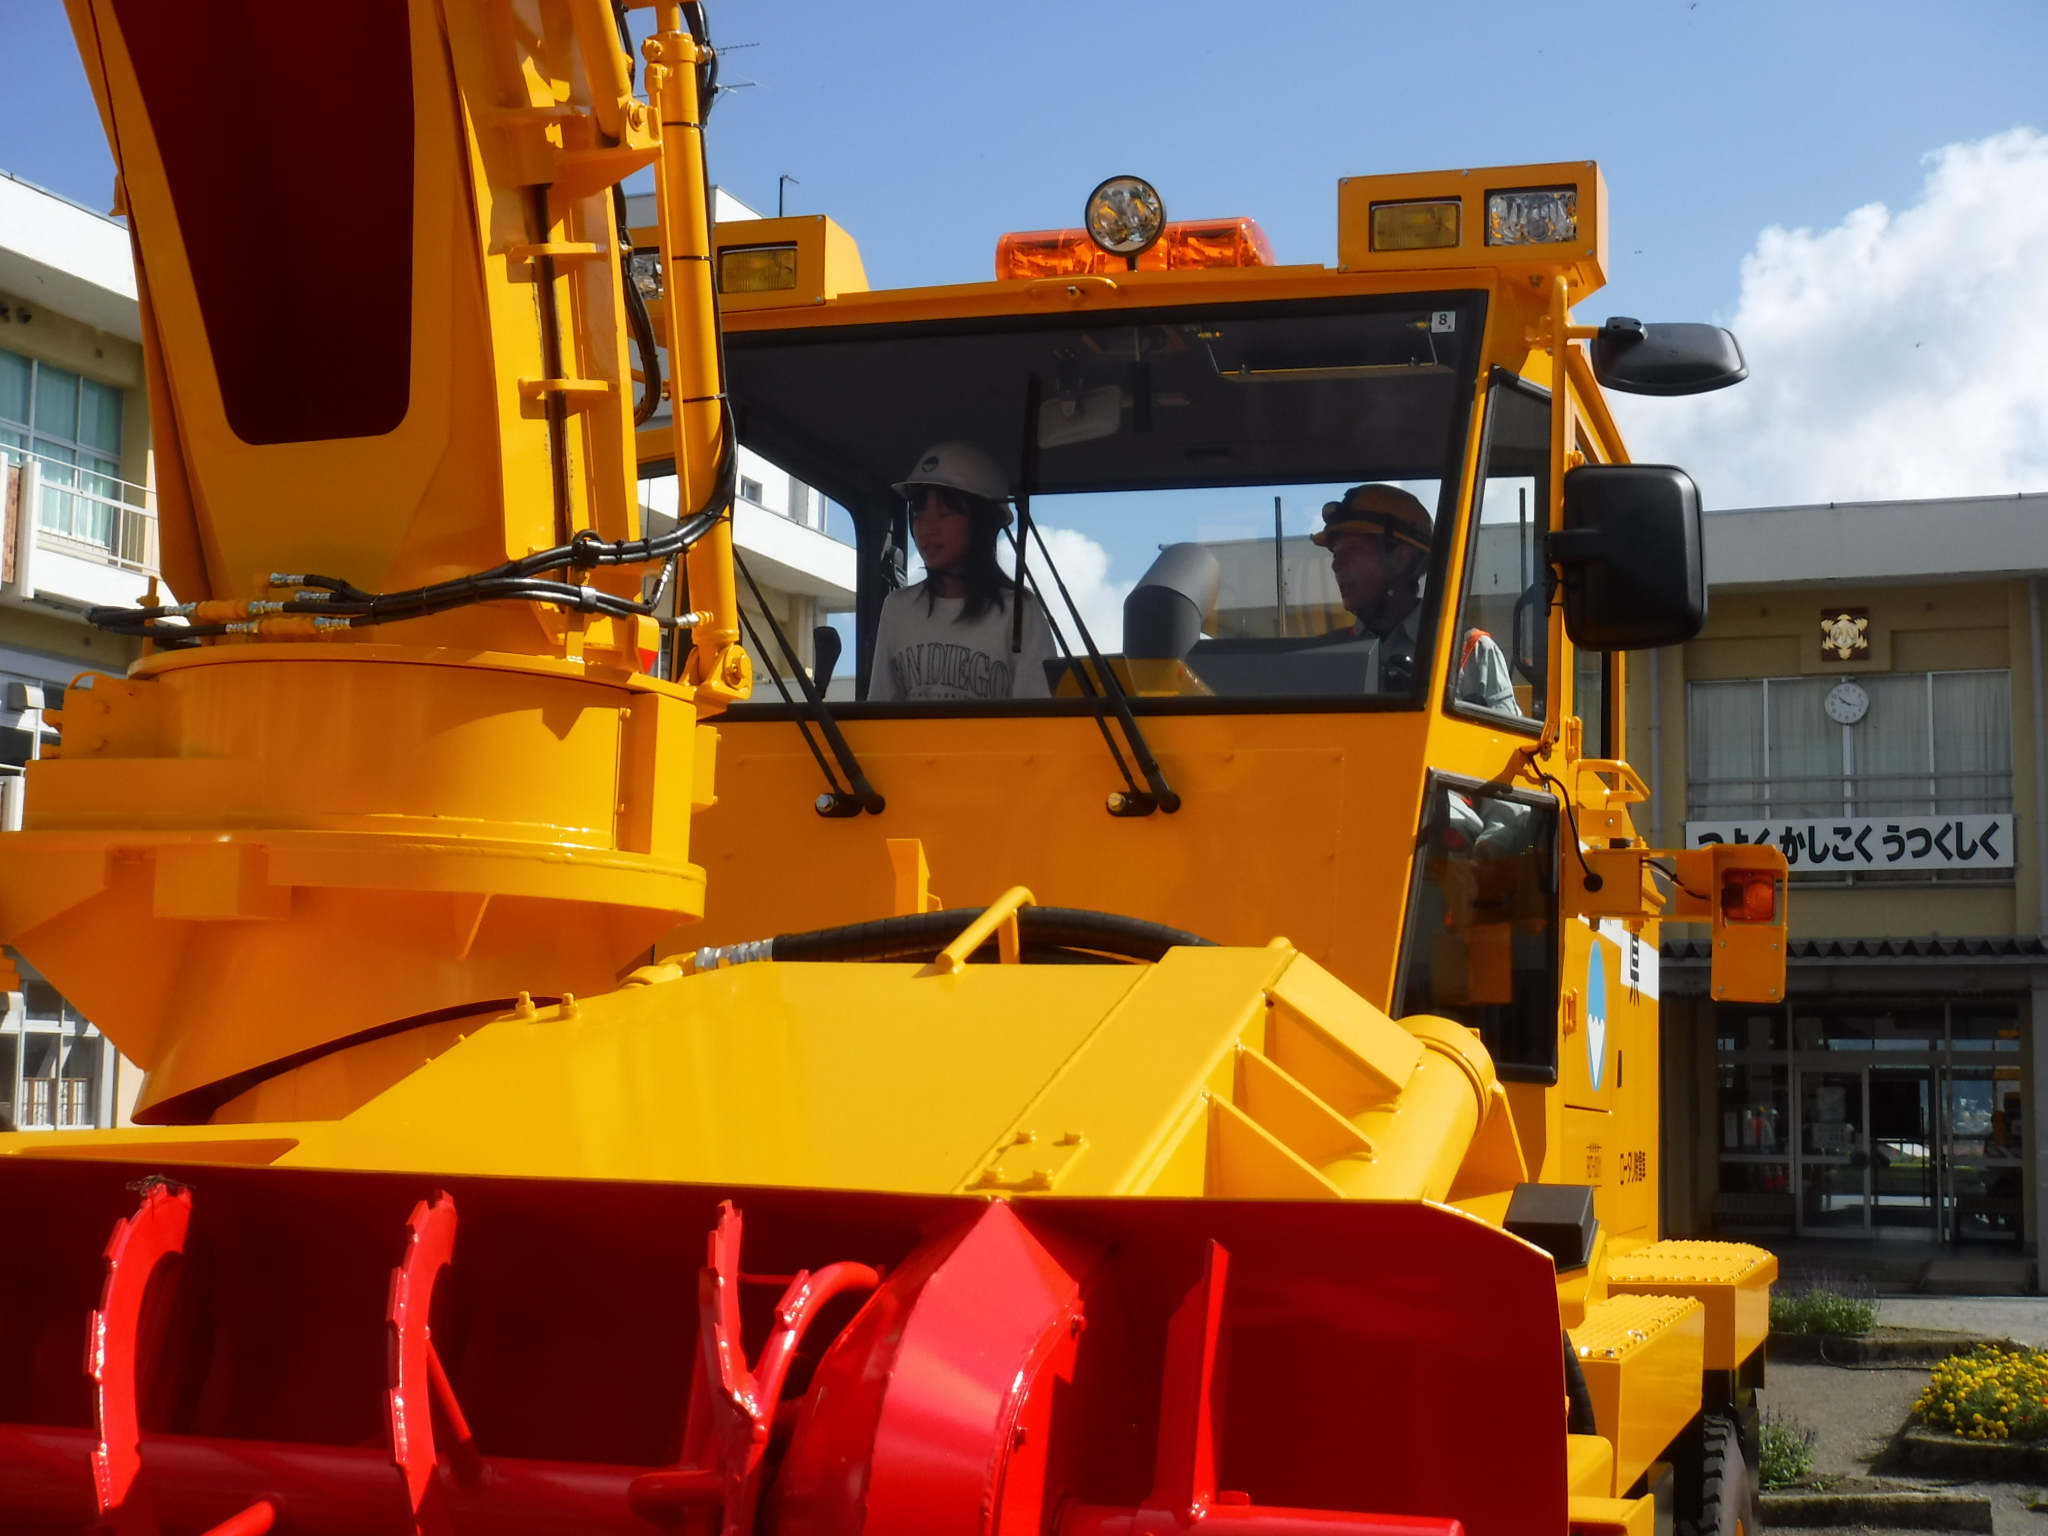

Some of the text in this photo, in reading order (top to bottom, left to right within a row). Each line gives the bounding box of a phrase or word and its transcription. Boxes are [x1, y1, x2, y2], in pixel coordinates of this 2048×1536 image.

[1438, 313, 1447, 326] 8
[926, 642, 1011, 698] DIEGO
[1779, 824, 1874, 865] かしこく
[1881, 821, 2000, 862] うつくしく
